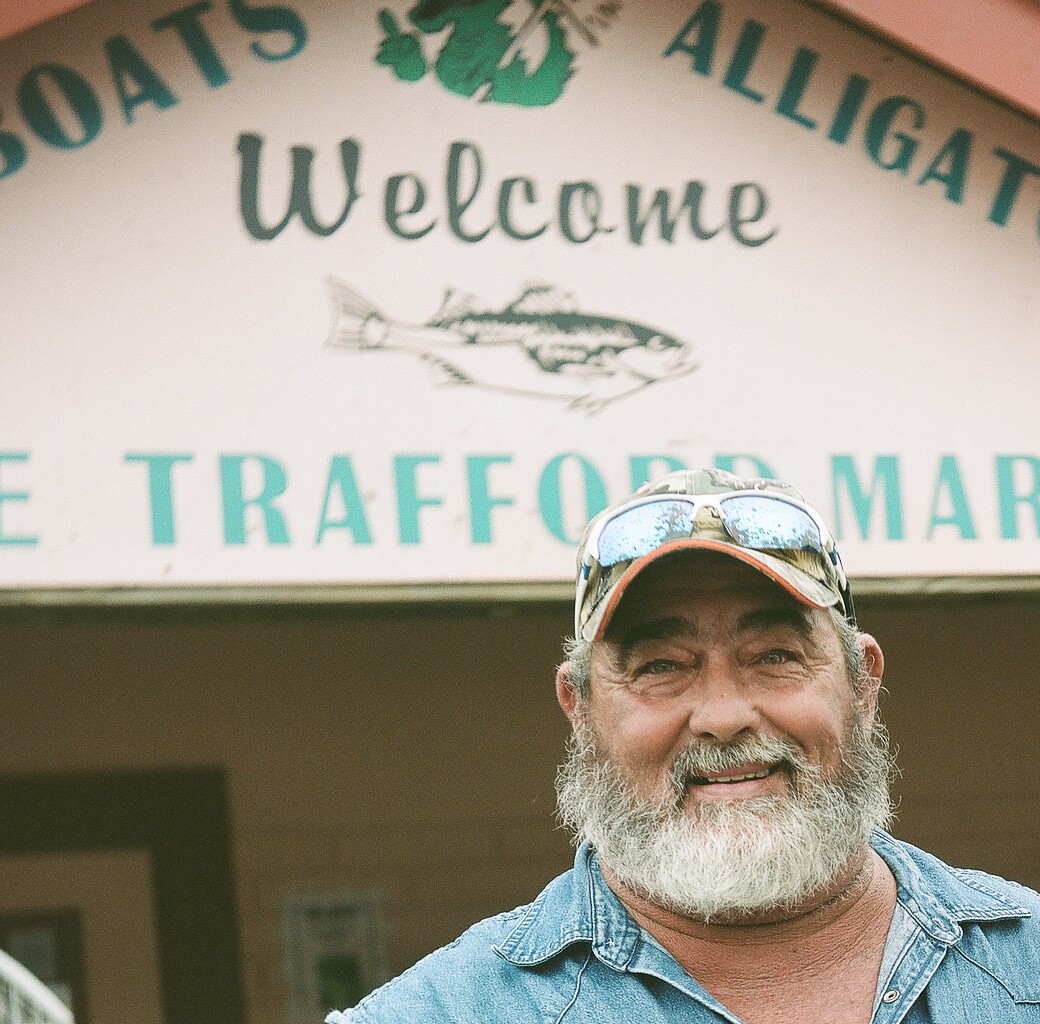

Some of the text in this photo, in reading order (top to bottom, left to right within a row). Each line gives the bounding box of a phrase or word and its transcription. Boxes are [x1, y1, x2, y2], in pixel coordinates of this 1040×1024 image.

[0, 0, 307, 179] OATS
[235, 131, 778, 247] Welcome
[123, 452, 776, 547] TRAFFO
